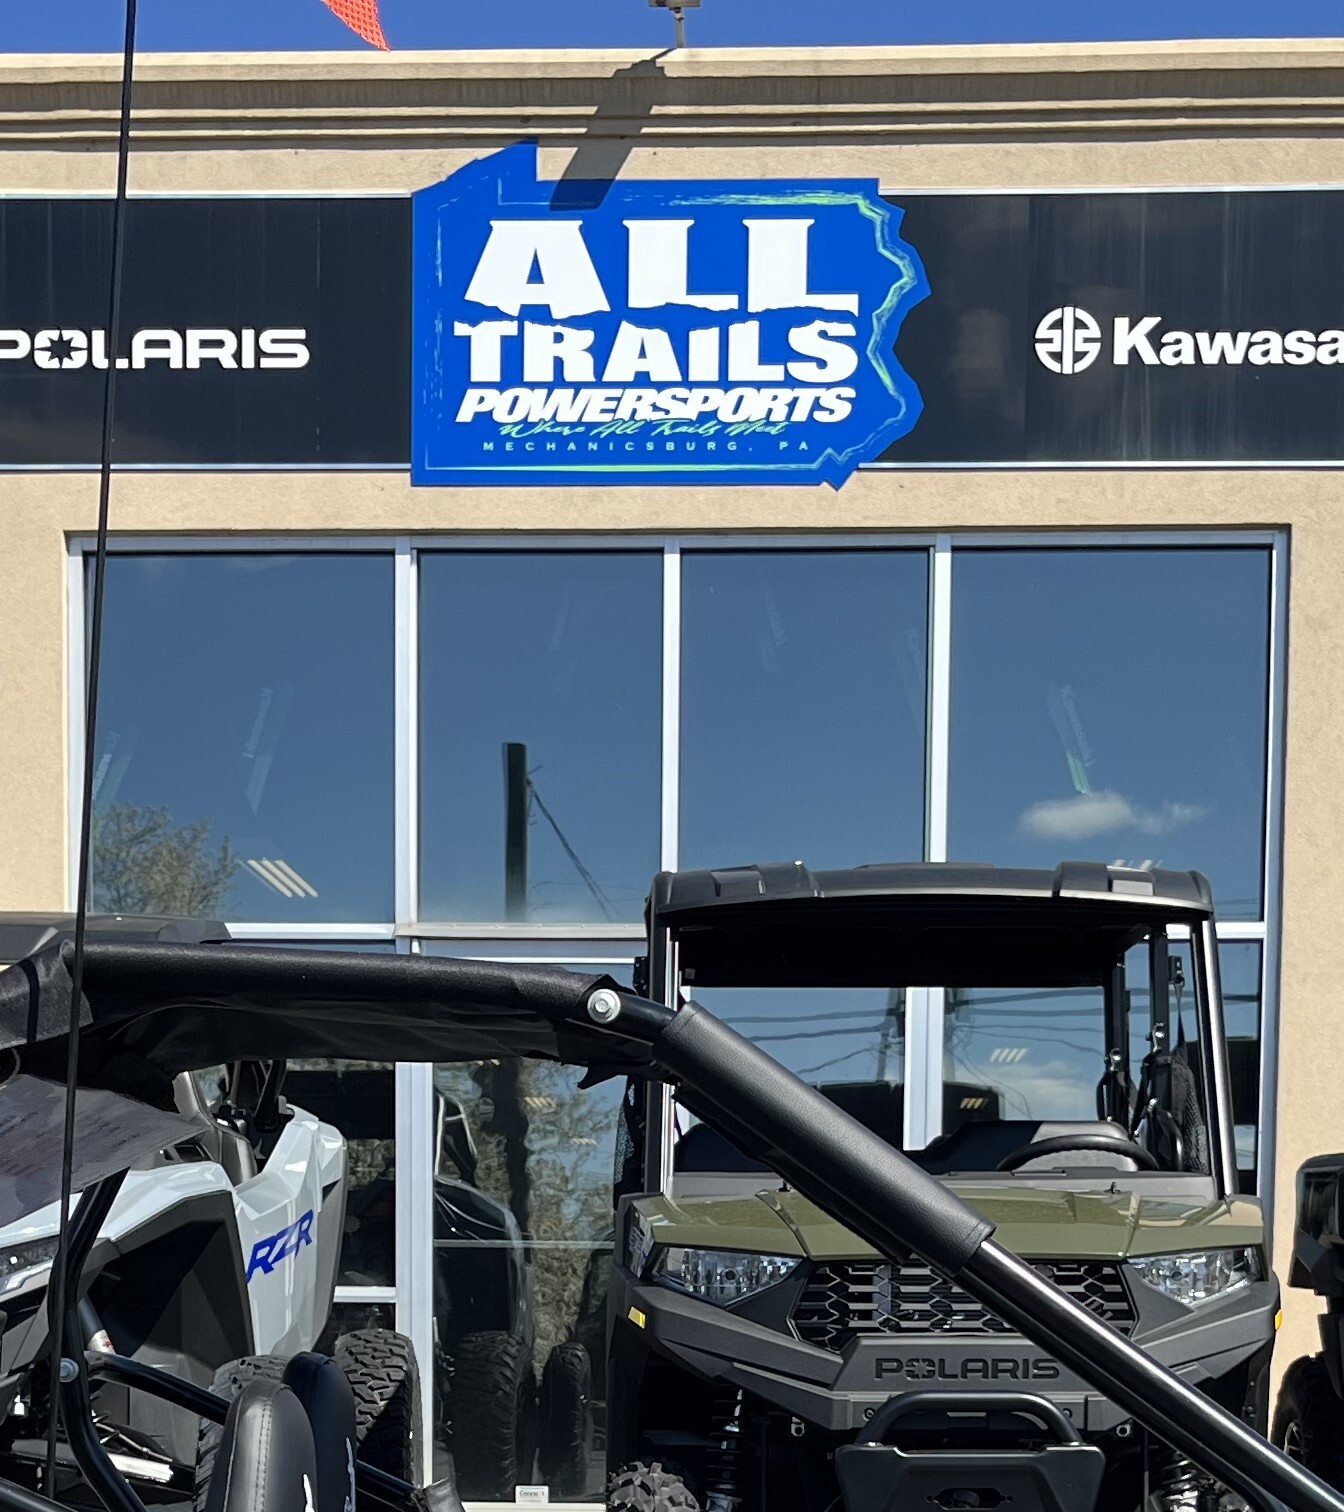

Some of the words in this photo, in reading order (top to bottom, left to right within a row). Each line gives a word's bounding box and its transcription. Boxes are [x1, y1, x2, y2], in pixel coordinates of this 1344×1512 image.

[464, 219, 858, 319] ALL
[453, 319, 858, 383] TRAILS
[455, 387, 857, 423] POWERSPORTS
[589, 420, 641, 437] All
[650, 418, 721, 437] Trails
[779, 441, 810, 452] PA
[246, 1209, 313, 1284] RZR
[874, 1357, 1060, 1380] POLARIS
